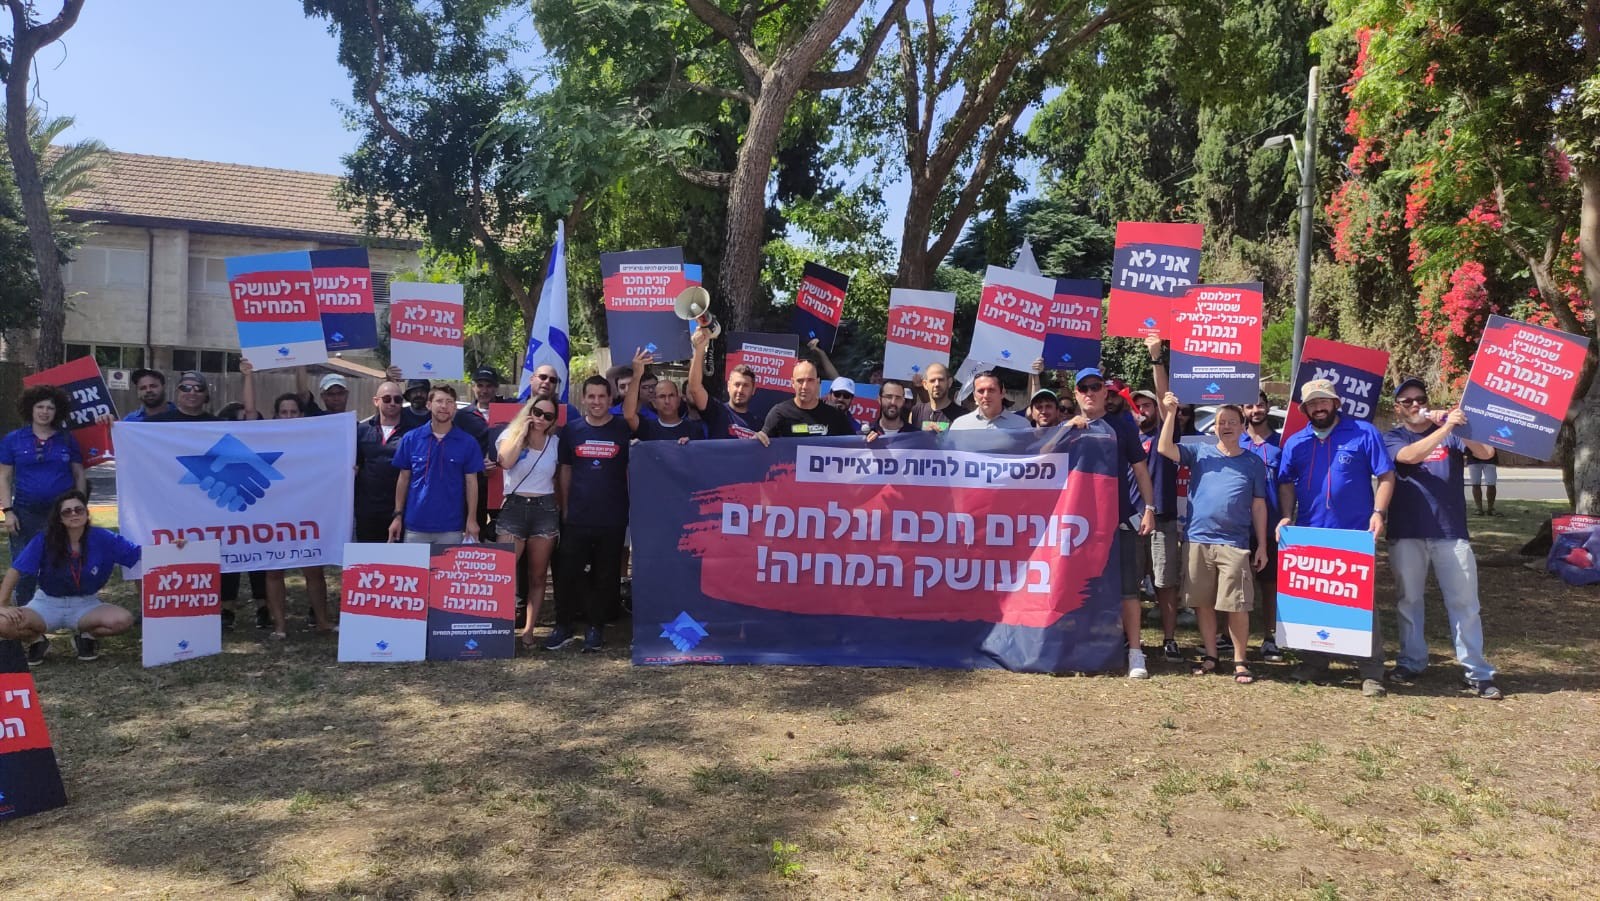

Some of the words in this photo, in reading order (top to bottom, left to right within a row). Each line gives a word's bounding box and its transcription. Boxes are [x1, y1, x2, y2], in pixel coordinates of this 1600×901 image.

[1129, 249, 1157, 268] לא
[1160, 254, 1190, 274] אני
[294, 281, 311, 295] די
[313, 275, 350, 290] לעוש
[352, 277, 368, 290] די
[623, 275, 644, 285] חכם
[645, 275, 671, 287] קונים
[234, 279, 292, 300] לעושק
[626, 286, 666, 295] ונלחמים
[801, 281, 832, 301] לעושק
[1197, 292, 1242, 302] דיפלומט,
[243, 299, 306, 314] המחיה!
[316, 293, 361, 306] המחי
[611, 296, 647, 306] המחיה!
[649, 297, 676, 308] עושק
[802, 293, 835, 318] המחיה!
[833, 295, 842, 308] די
[993, 291, 1017, 308] לא
[1019, 298, 1044, 318] אני
[1195, 302, 1240, 313] שסטוביץ,
[404, 304, 427, 320] לא
[430, 309, 455, 325] אני
[1050, 302, 1083, 316] לעוש
[1086, 306, 1099, 318] די
[900, 310, 921, 326] לא
[923, 315, 946, 331] אני
[983, 303, 1046, 333] פראיירית!
[1047, 316, 1091, 332] המחיה
[396, 320, 462, 340] פראיירית!
[892, 325, 949, 346] פראיירית!
[1191, 324, 1238, 338] נגמרה
[1184, 338, 1242, 355] החגיגה!
[1514, 329, 1564, 352] דיפלומט,
[743, 353, 761, 364] חכם
[1508, 339, 1561, 361] שסטוביץ,
[749, 364, 779, 376] ונלחמי
[762, 356, 785, 369] קונים
[1497, 360, 1549, 388] נגמרה
[72, 386, 100, 404] אני
[1342, 375, 1372, 398] אני
[1483, 372, 1549, 406] החגיגה!
[66, 404, 110, 426] פראי
[809, 455, 899, 476] פראיירים
[902, 454, 959, 478] להיות
[964, 457, 1057, 482] מפסיקים
[721, 501, 881, 542] ונלחמים
[891, 509, 974, 546] חכם
[151, 520, 320, 546] ההסתדרות
[985, 514, 1090, 556] קונים
[221, 551, 262, 564] העובד
[266, 550, 286, 560] של
[290, 548, 322, 559] הבית
[454, 550, 496, 560] דיפלומט,
[453, 560, 496, 571] שסטוביץ,
[756, 546, 903, 588] המחיה!
[1282, 553, 1347, 576] לעושק
[1350, 563, 1370, 581] די
[158, 571, 183, 591] לא
[186, 572, 213, 590] אני
[358, 570, 386, 590] לא
[389, 574, 419, 593] אני
[912, 556, 1051, 597] בעושק
[1288, 571, 1359, 599] המחיה!
[450, 582, 493, 595] נגמרה
[149, 593, 219, 610] פראיירית!
[347, 590, 425, 611] פראיירית!
[443, 595, 498, 611] החגיגה!
[4, 689, 31, 709] די
